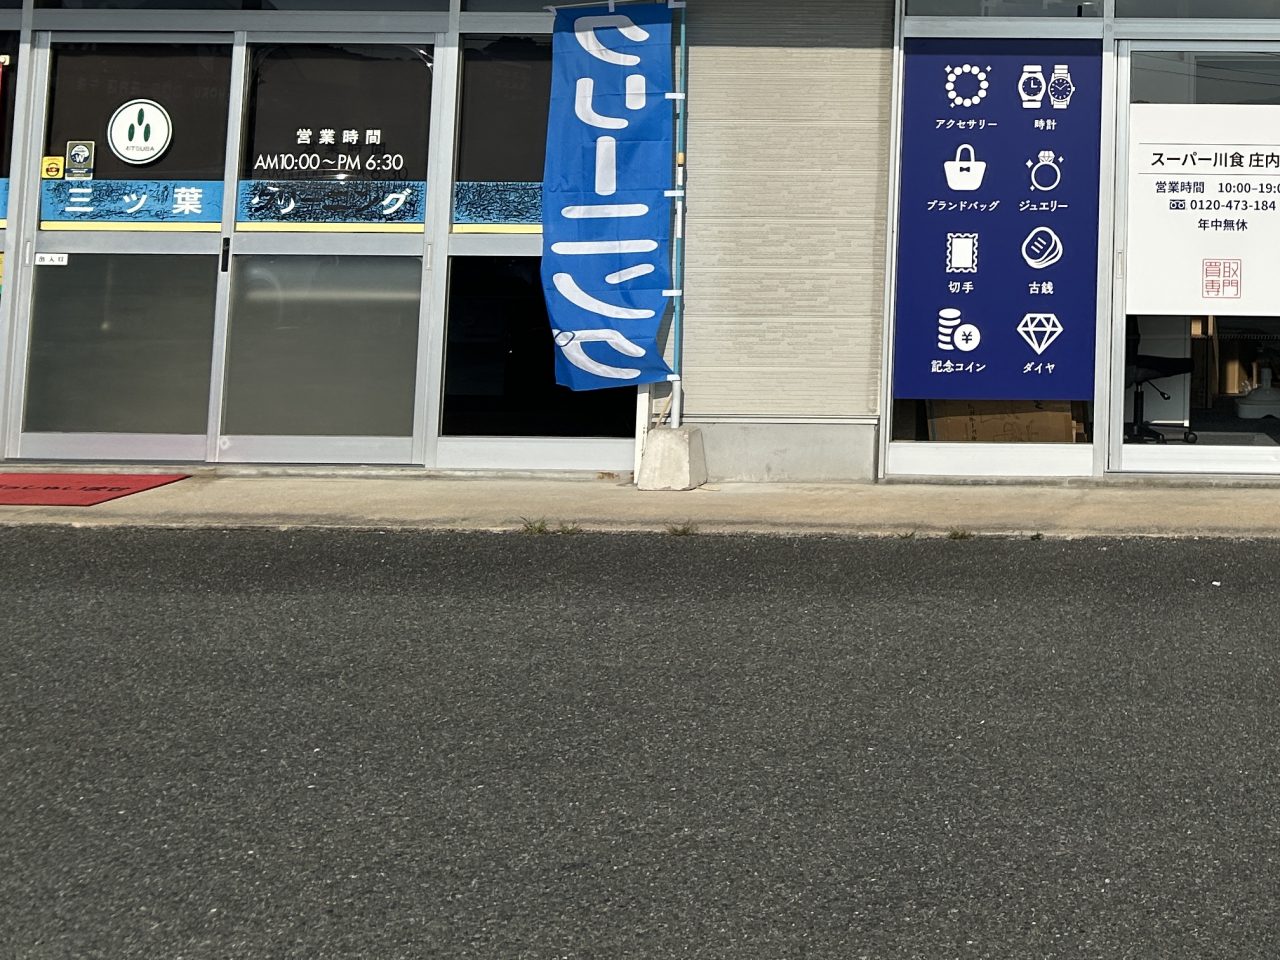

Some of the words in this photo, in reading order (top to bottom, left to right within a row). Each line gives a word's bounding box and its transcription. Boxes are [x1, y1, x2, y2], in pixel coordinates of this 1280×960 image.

[935, 118, 998, 130] アクセサリー
[1033, 118, 1057, 131] 時計
[297, 128, 382, 145] 営業時間
[366, 154, 404, 171] 6:30
[1151, 151, 1245, 168] スーパー川食
[1155, 181, 1205, 194] 営業時間
[927, 199, 1001, 212] ブランドバッグ
[1019, 200, 1069, 212] ジュエリー
[1190, 199, 1276, 211] 0120-473-184
[1197, 218, 1248, 232] 年中無休
[948, 281, 974, 294] 切手
[1028, 281, 1054, 295] 古銭
[931, 360, 986, 373] 記念コイン
[1023, 362, 1056, 374] ダイヤ
